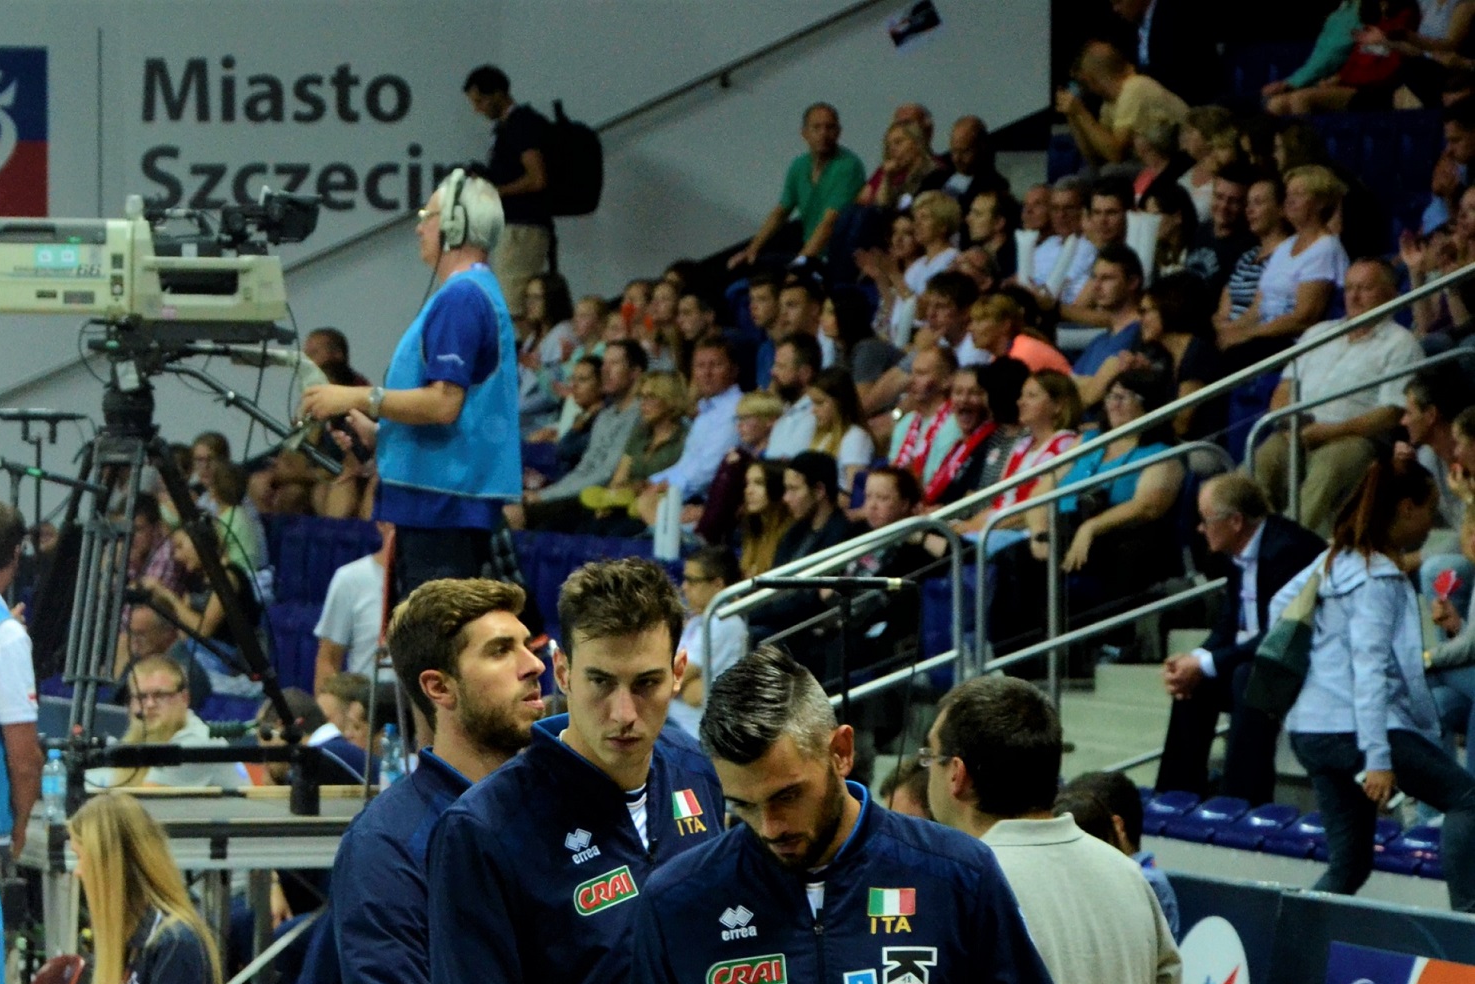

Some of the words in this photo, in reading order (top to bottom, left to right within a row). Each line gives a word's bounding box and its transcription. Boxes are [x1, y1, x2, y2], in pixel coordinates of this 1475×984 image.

[142, 55, 412, 123] Miasto
[677, 816, 707, 836] ITA
[571, 844, 601, 865] errea
[578, 872, 633, 910] CRAI
[721, 925, 757, 941] errea
[870, 916, 912, 934] ITA
